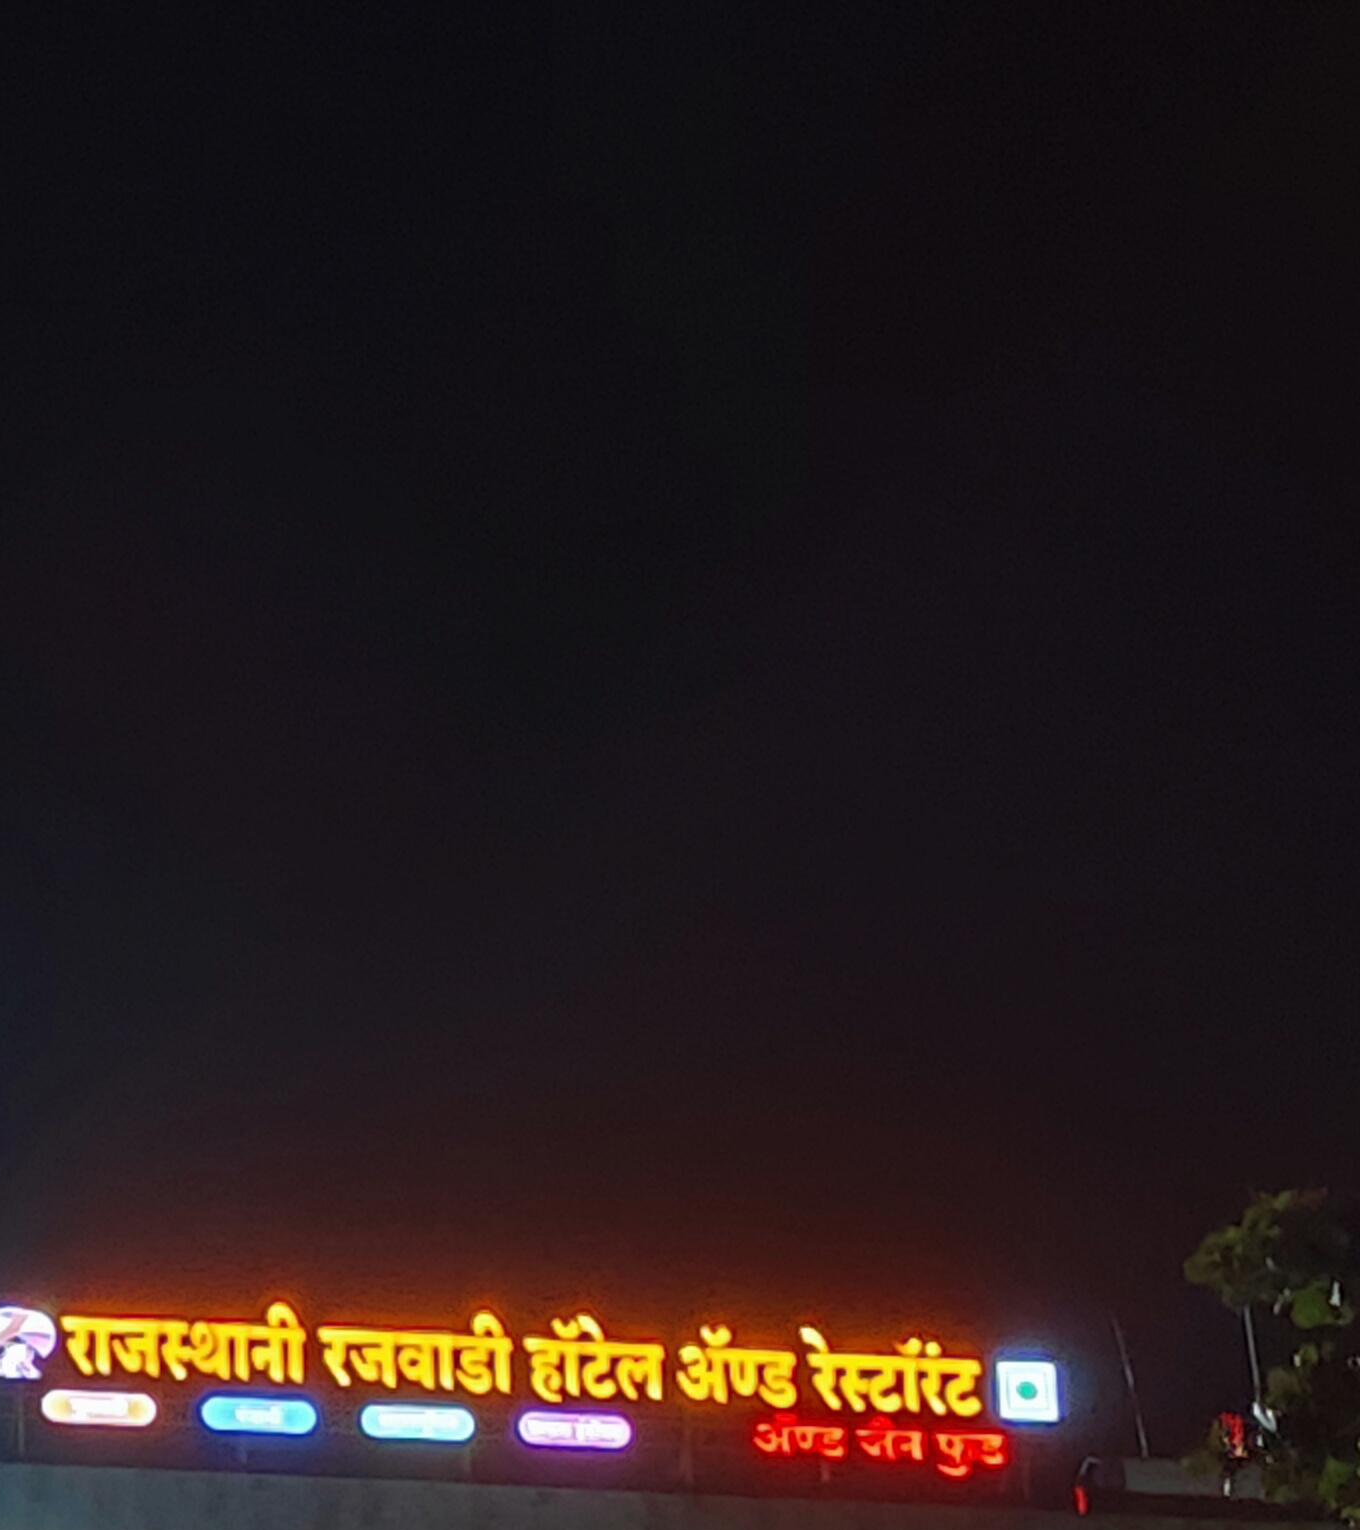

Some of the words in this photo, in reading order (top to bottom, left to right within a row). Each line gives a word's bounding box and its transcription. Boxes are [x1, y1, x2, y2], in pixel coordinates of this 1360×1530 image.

[60, 1302, 306, 1384] राजस्थानी
[317, 1312, 514, 1395] रजवाडी
[523, 1314, 665, 1404] हॉटेल
[799, 1326, 982, 1417] रेस्टॉरंट
